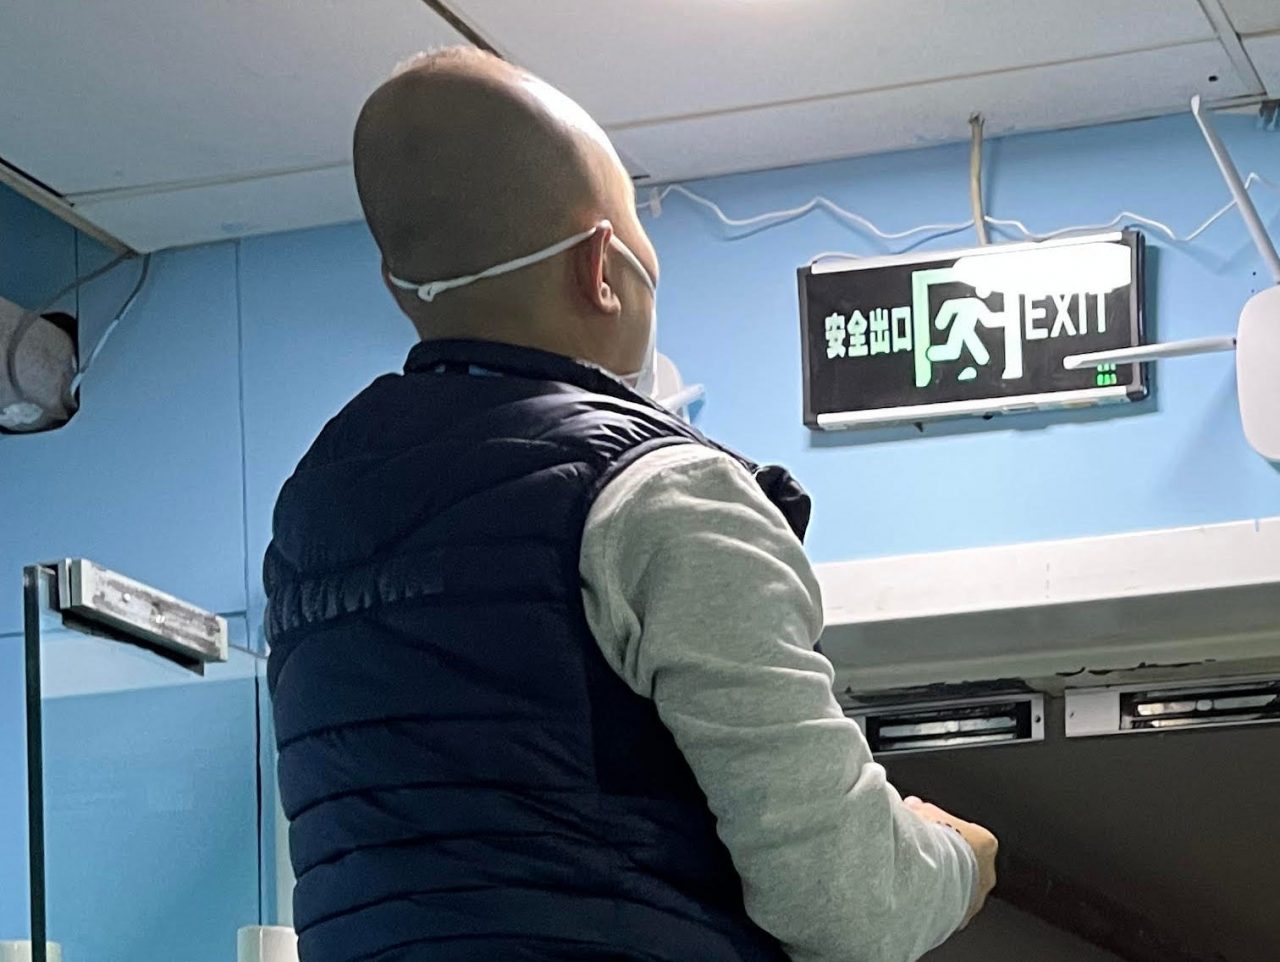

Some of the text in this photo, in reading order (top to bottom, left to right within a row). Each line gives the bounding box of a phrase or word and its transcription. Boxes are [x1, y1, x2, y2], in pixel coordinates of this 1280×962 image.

[824, 306, 912, 359] 安全出口
[1024, 290, 1112, 340] EXIT
